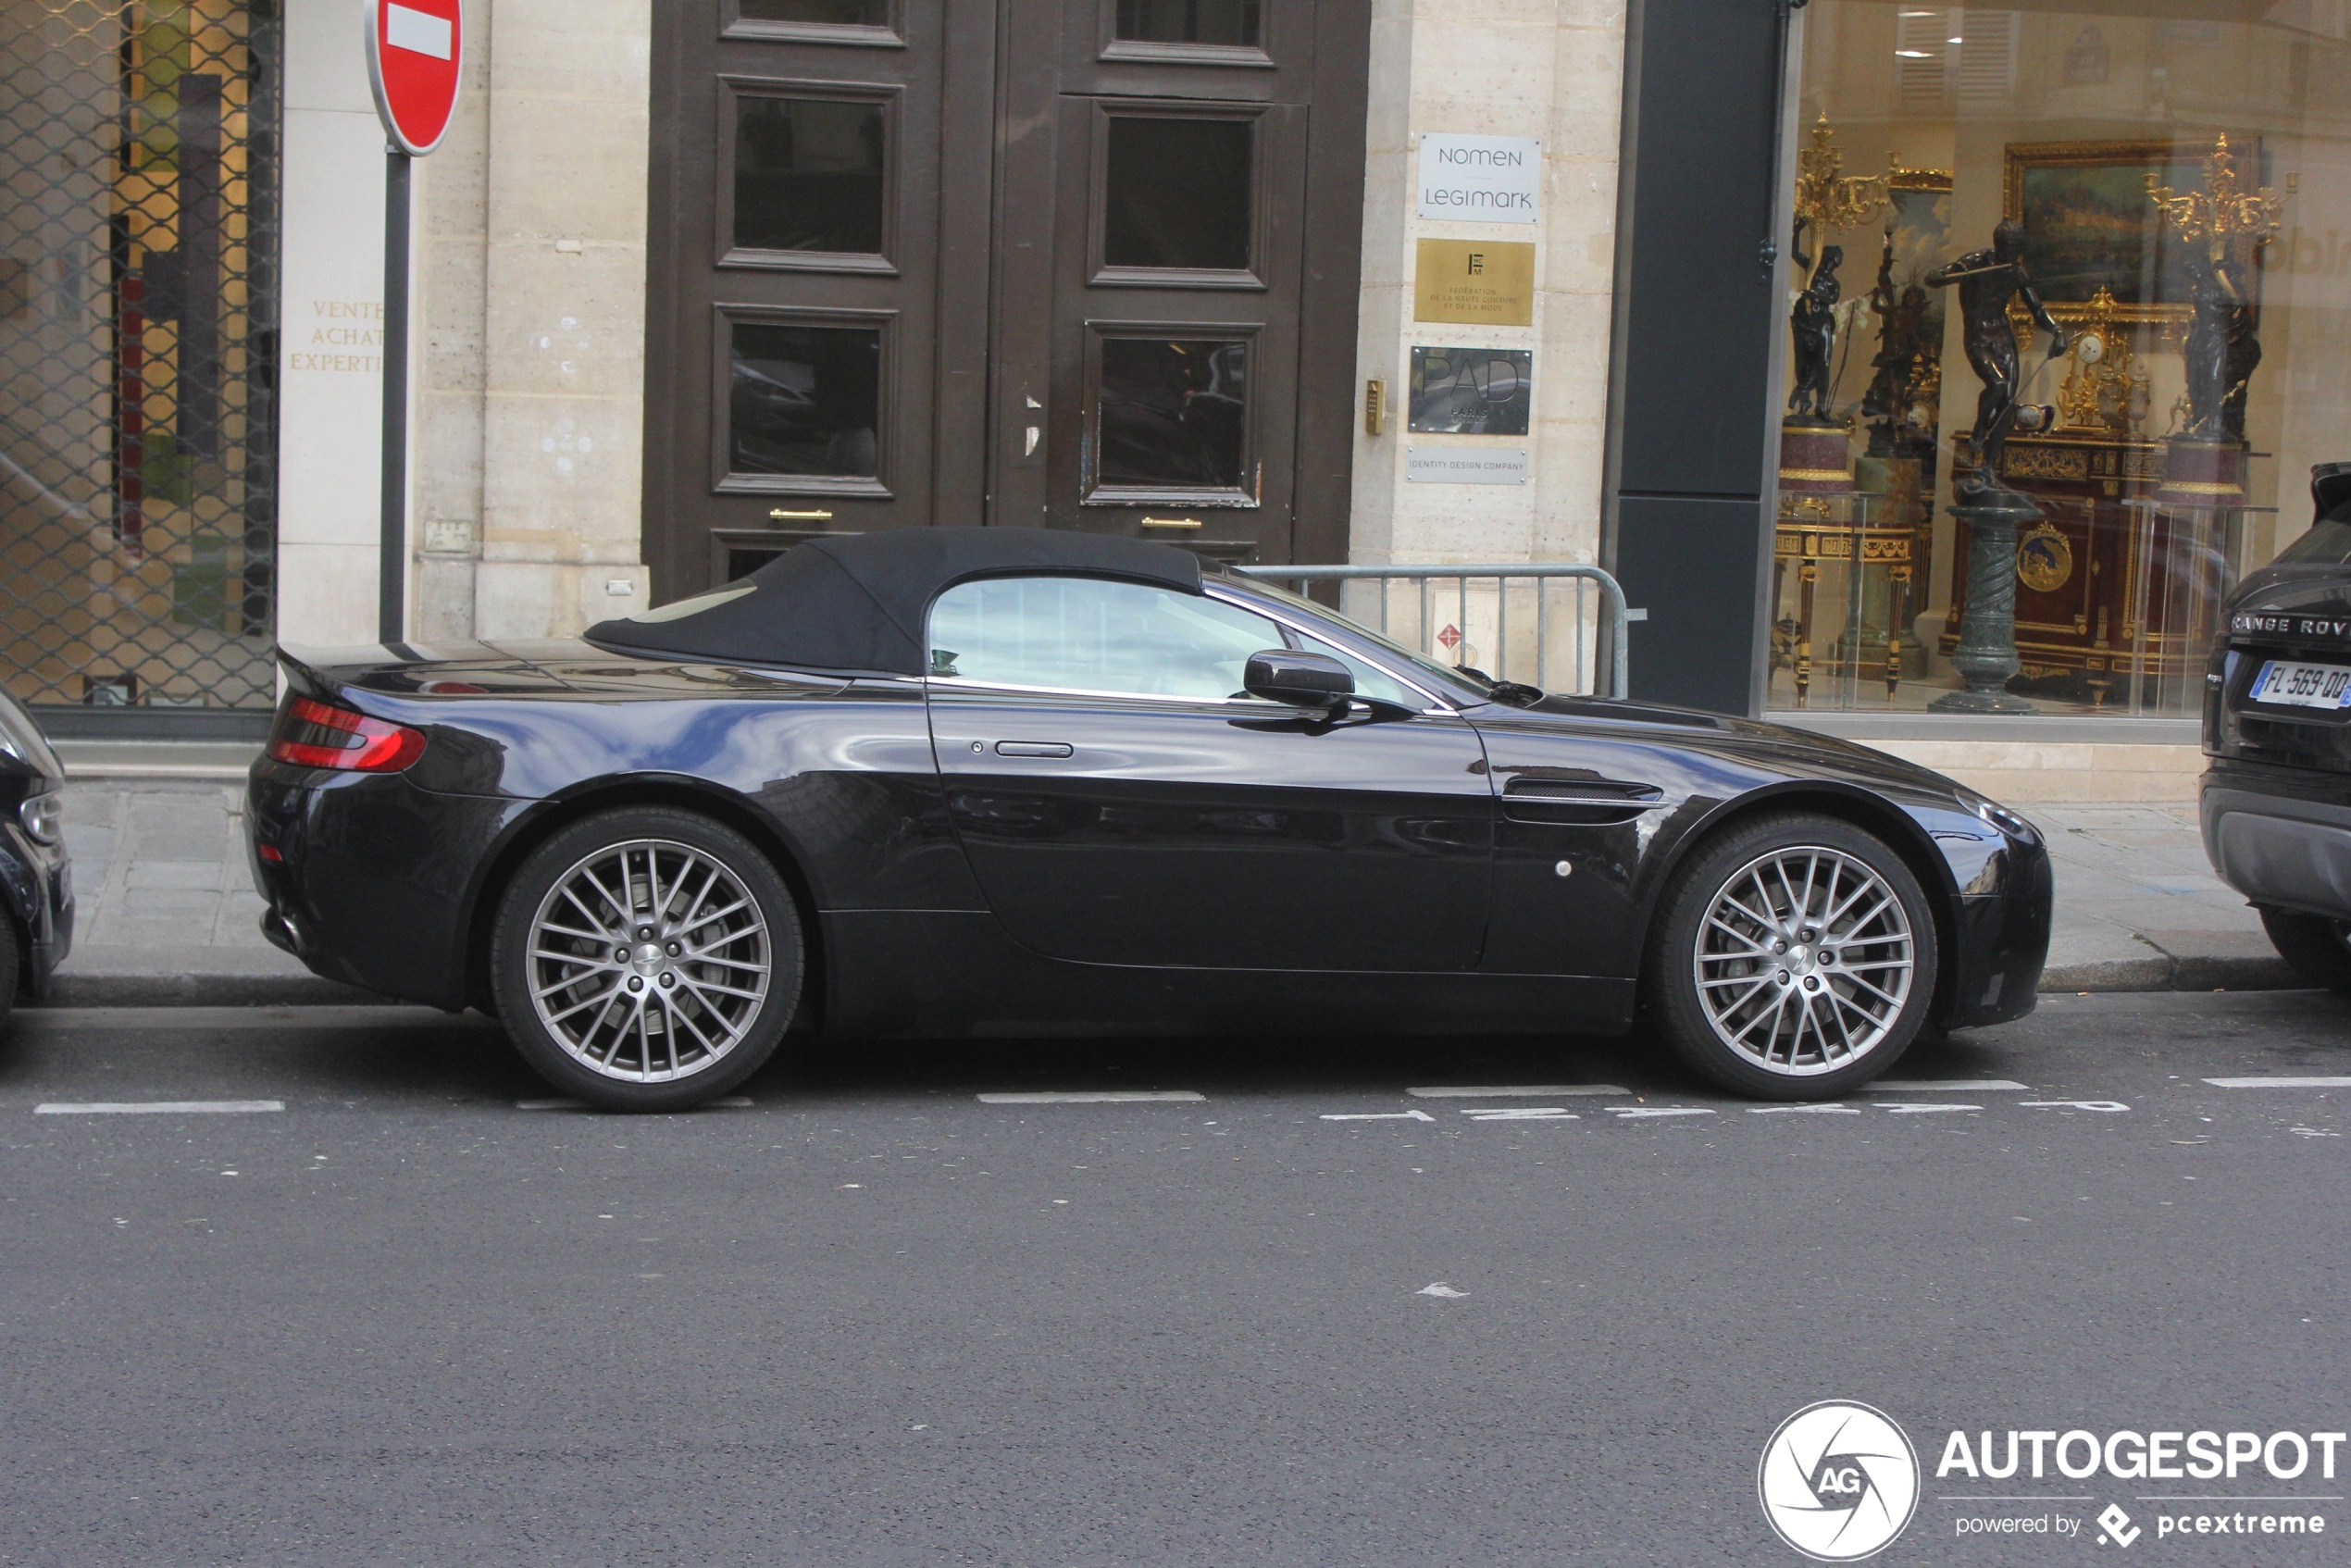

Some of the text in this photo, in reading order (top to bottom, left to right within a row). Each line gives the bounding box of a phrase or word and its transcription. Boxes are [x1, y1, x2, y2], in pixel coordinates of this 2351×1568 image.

[1482, 296, 1518, 305] COUTURE
[312, 301, 384, 319] VENTE
[291, 354, 382, 372] EXPERTI
[1422, 356, 1519, 403] PAD
[1450, 407, 1488, 417] PARIS
[1409, 460, 1524, 470] IDENTITY DESIGN COMPANY
[2231, 616, 2351, 637] RANGE ROV
